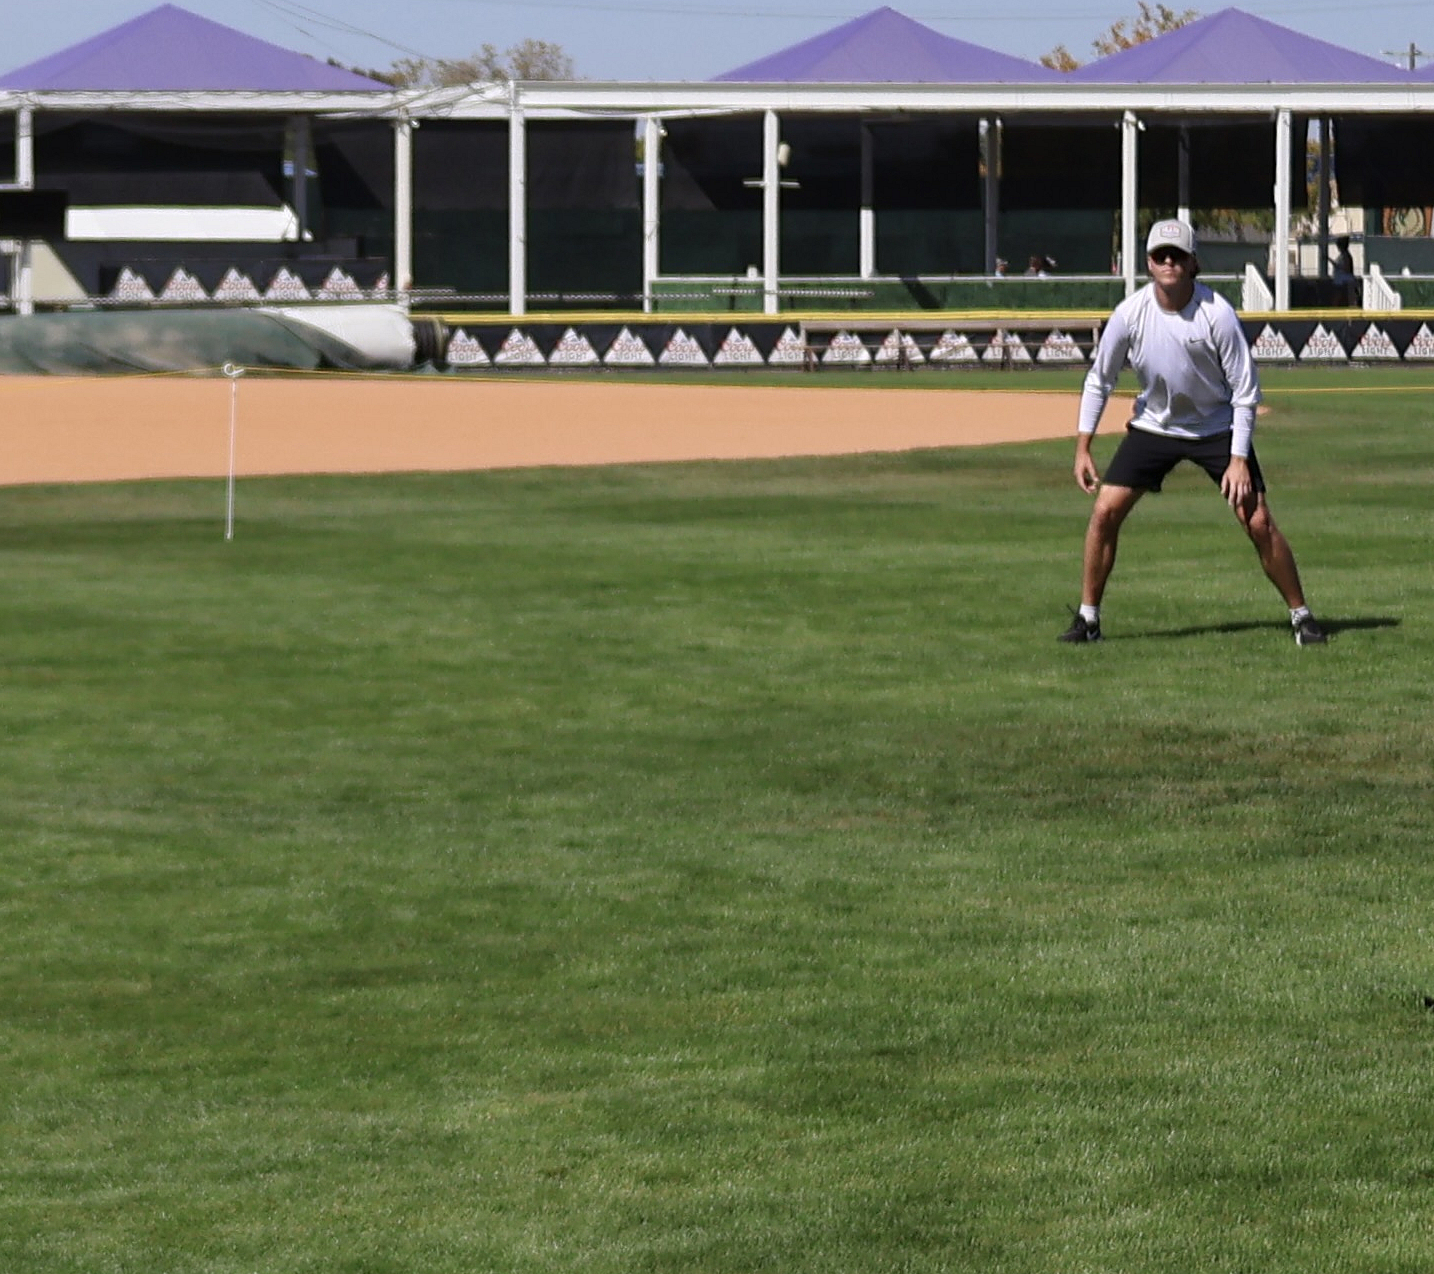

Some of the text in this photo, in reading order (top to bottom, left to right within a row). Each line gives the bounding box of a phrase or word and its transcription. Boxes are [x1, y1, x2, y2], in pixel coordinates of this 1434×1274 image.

[118, 280, 145, 292] Coors
[168, 280, 199, 292] Coors
[221, 280, 253, 292] Coors
[271, 280, 304, 292] Coors
[448, 339, 481, 353] Coors
[501, 339, 536, 353] Coors
[556, 339, 590, 353] Coors
[611, 339, 645, 352] Coors
[665, 339, 700, 352] Coors
[720, 339, 754, 352] Coors
[1255, 335, 1286, 348] Coors
[1306, 335, 1338, 348] Coors
[1358, 334, 1391, 347] Coors
[559, 352, 588, 360] LIGHT
[615, 352, 644, 360] LIGHT
[669, 352, 697, 360] LIGHT
[724, 352, 752, 360] LIGHT
[834, 350, 863, 359] LIGHT
[1046, 349, 1073, 357] LIGHT
[1257, 347, 1283, 355] LIGHT
[1310, 347, 1336, 355] LIGHT
[1362, 346, 1388, 354] LIGHT
[449, 353, 477, 361] LIGHT
